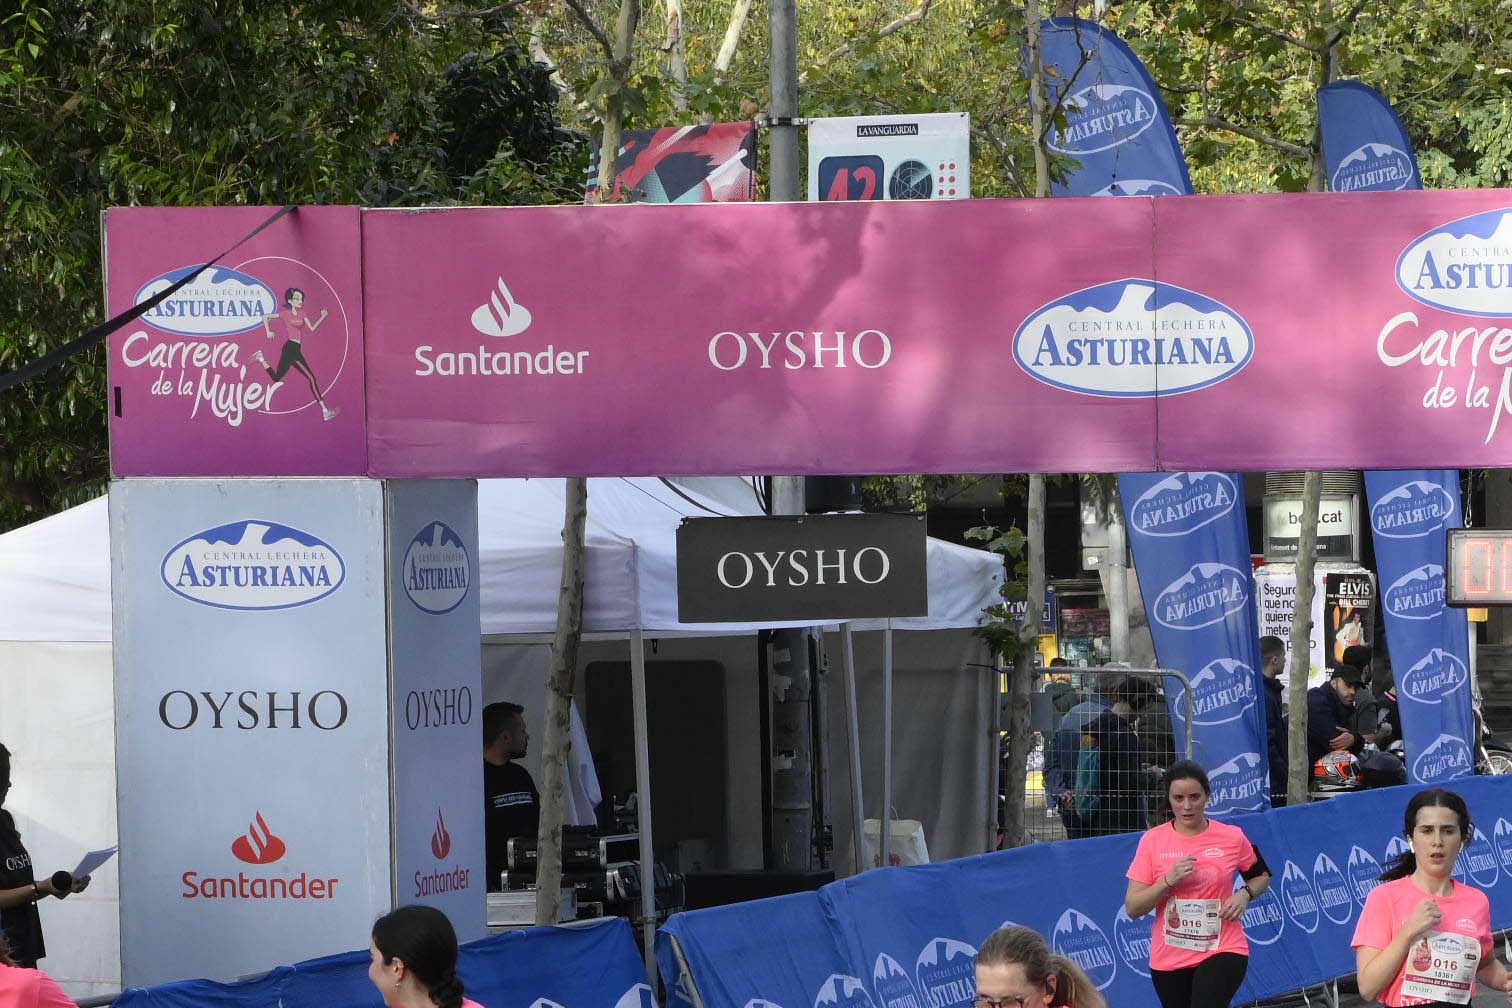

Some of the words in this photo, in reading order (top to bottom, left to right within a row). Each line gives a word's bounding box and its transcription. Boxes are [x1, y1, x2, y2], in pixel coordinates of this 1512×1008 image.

[1069, 320, 1143, 332] CENTRAL
[122, 331, 240, 368] Carrera
[415, 344, 589, 377] Santander
[707, 329, 892, 370] OYSHO
[1032, 324, 1235, 366] ASTURIANA
[152, 370, 172, 395] de
[178, 369, 193, 396] la
[191, 365, 283, 426] Mujer
[1423, 371, 1457, 409] de
[1465, 372, 1489, 409] la
[176, 554, 332, 587] ASTURIANA
[203, 552, 261, 560] CENTRAL
[267, 551, 327, 560] LECHERA
[717, 547, 890, 588] OYSHO
[408, 556, 466, 592] ASTURIANA
[1339, 583, 1370, 594] ELVIS
[158, 690, 348, 730] OYSHO
[405, 686, 472, 730] OYSHO
[182, 871, 338, 898] Santander
[415, 865, 470, 898] Santander
[1182, 919, 1202, 928] 016
[1434, 959, 1458, 970] 016
